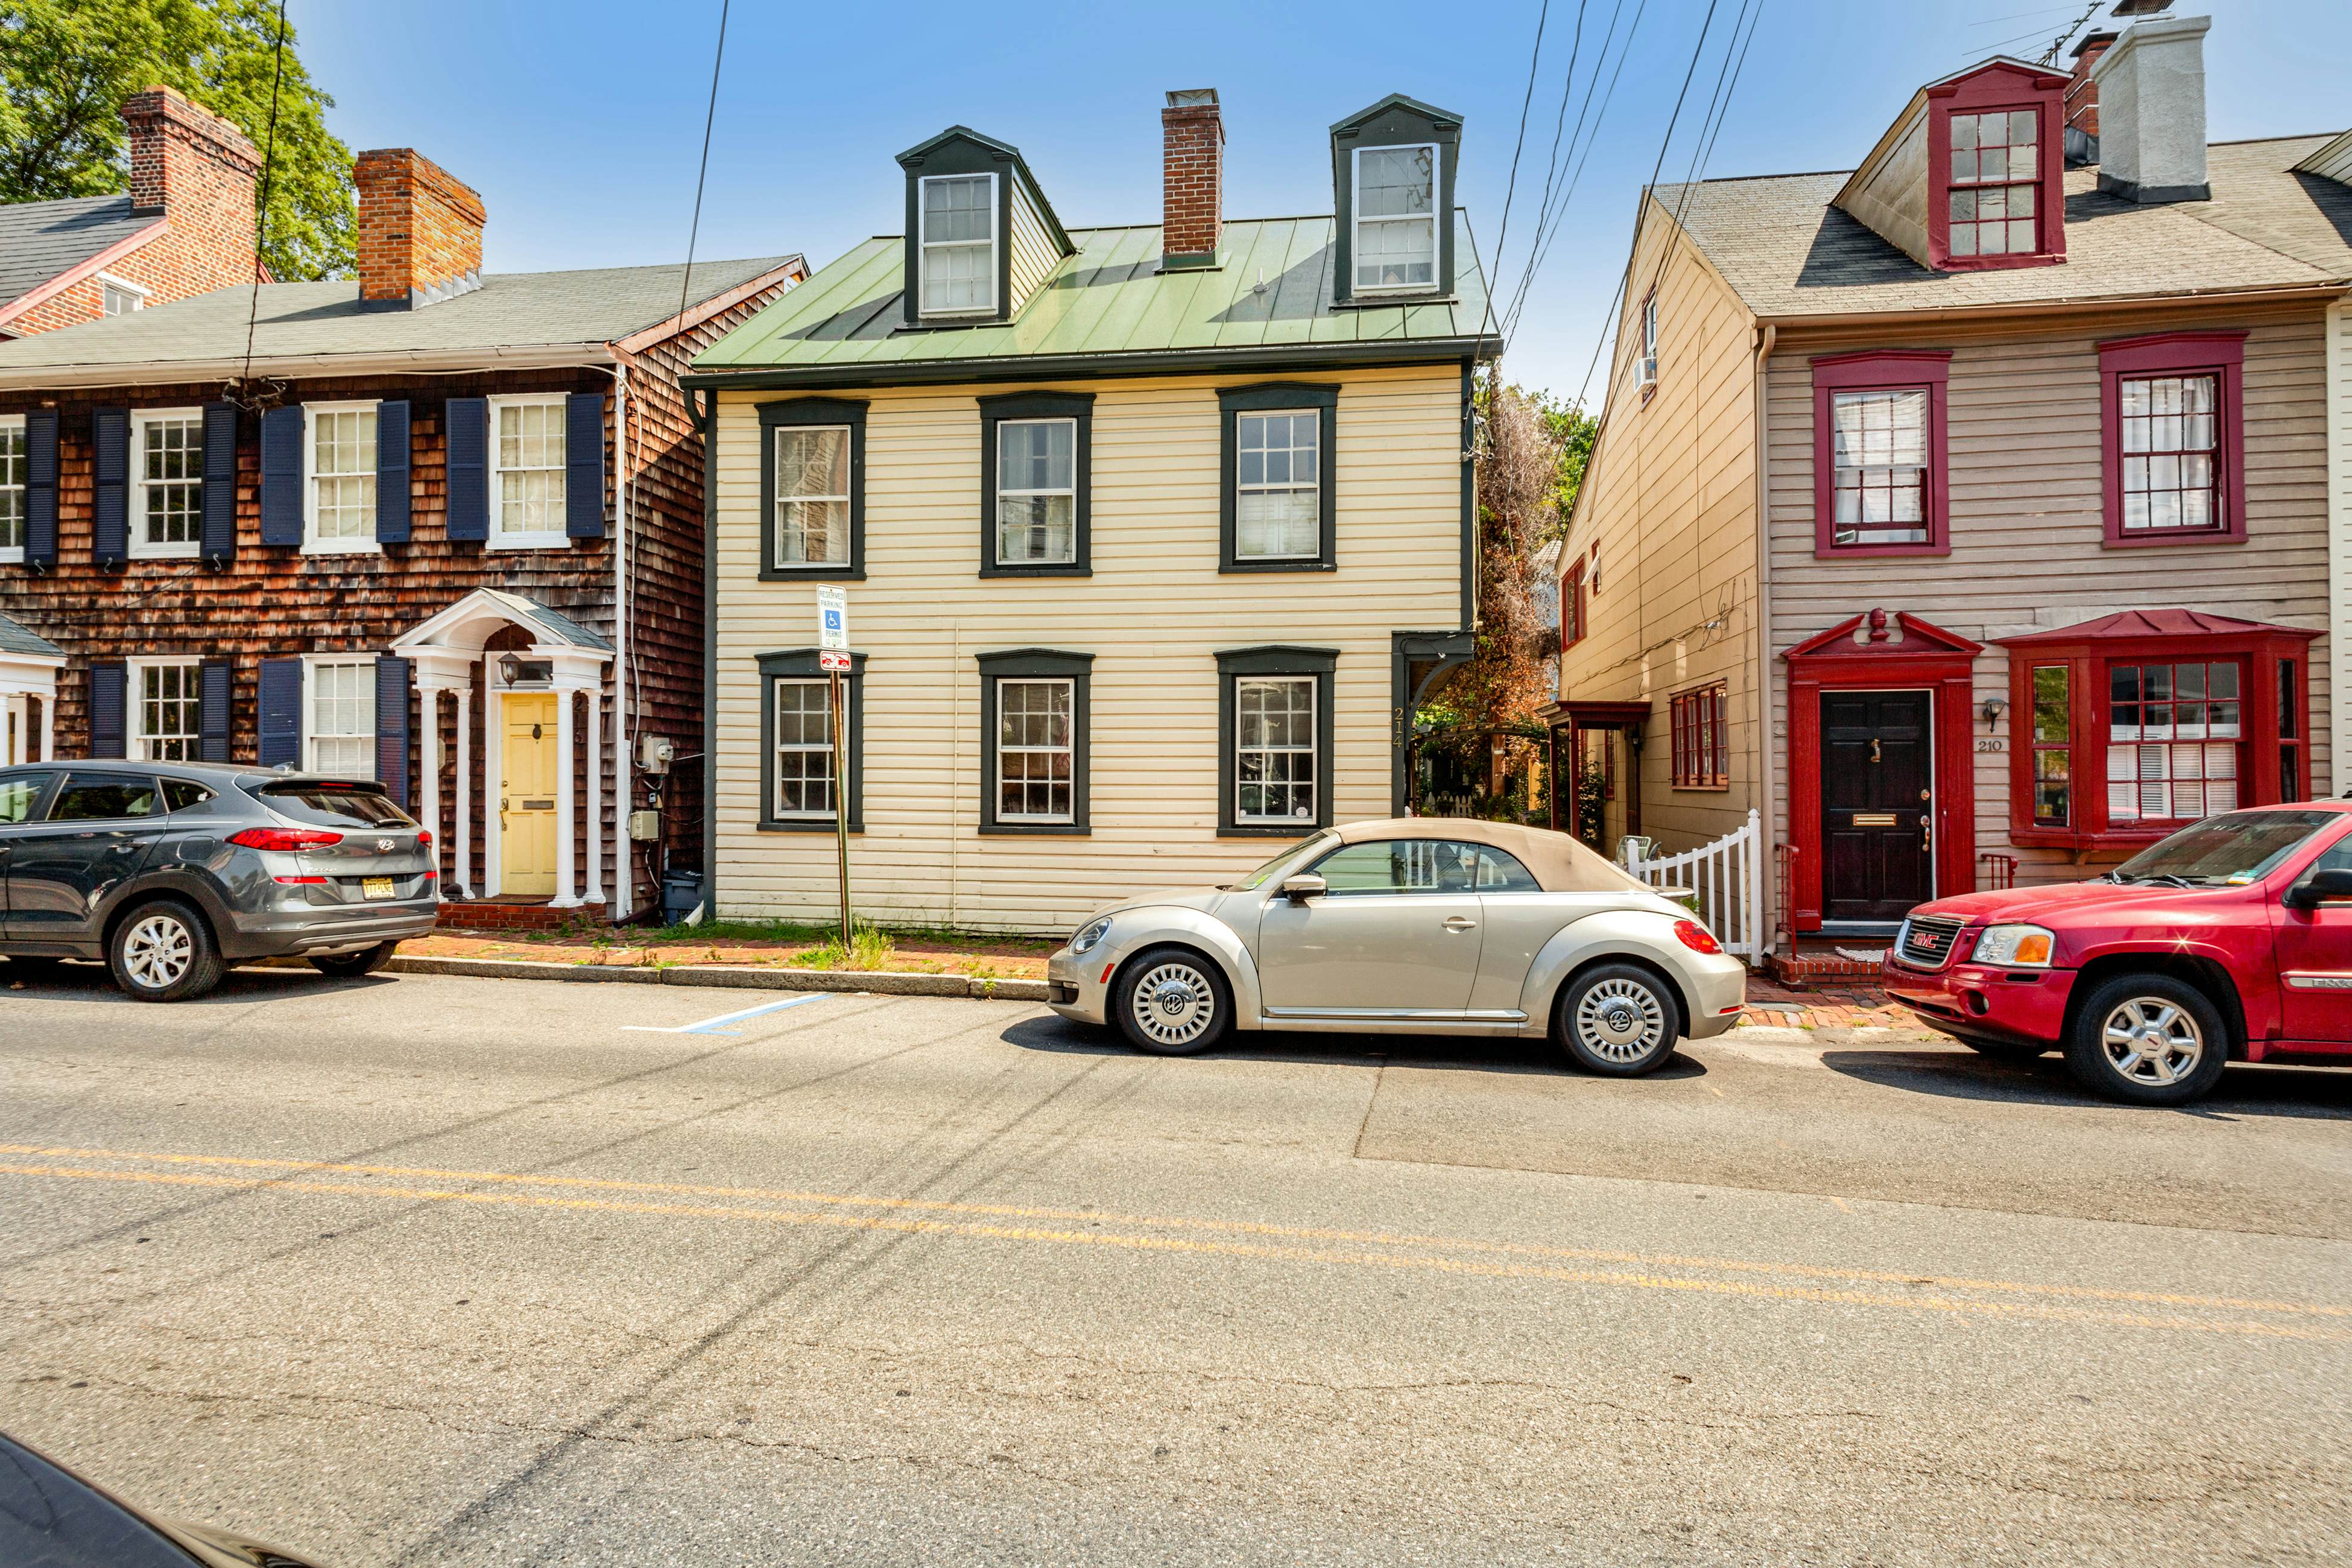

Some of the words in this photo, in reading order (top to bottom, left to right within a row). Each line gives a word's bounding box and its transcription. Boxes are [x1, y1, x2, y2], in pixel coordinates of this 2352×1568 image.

[819, 590, 844, 600] RESERVED
[820, 599, 842, 609] PARKING
[826, 630, 842, 638] PERMIT
[1393, 707, 1403, 748] 214
[1978, 740, 2002, 751] 210
[1912, 932, 1939, 949] GMC
